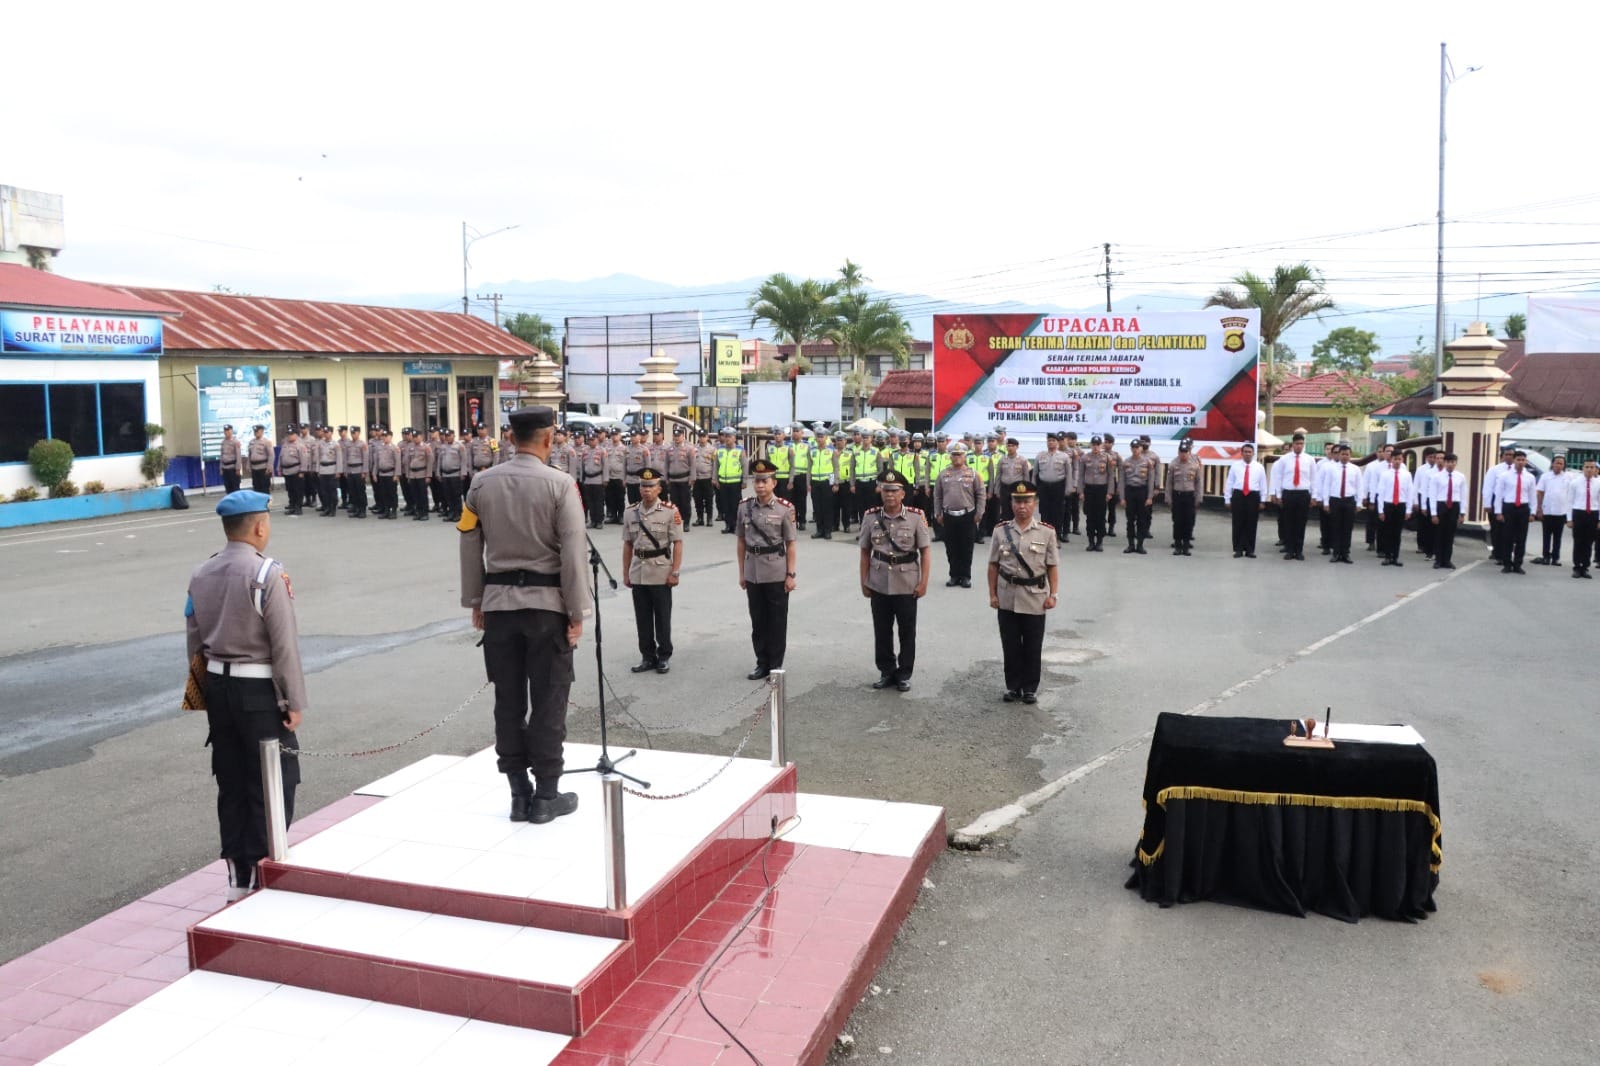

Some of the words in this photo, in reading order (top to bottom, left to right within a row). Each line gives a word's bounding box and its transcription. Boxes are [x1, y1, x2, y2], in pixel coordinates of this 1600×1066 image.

[33, 316, 139, 333] PELAYANAN
[1043, 317, 1141, 333] UPACARA
[15, 331, 56, 343] SURAT
[60, 333, 84, 344] IZIN
[88, 333, 153, 345] MENGEMUDI
[989, 335, 1022, 350] SERAH
[1024, 335, 1064, 350] TERIMA
[1066, 335, 1112, 350] JABATAN
[1113, 335, 1136, 350] dan
[1138, 335, 1207, 350] PELANTIKAN
[1047, 354, 1074, 362] SERAH
[1076, 354, 1107, 362] TERIMA
[1108, 354, 1145, 362] JABATAN
[1112, 366, 1136, 374] KERINCI
[1017, 377, 1030, 386] AKP
[1031, 377, 1046, 386] YUDI
[1119, 378, 1132, 387] AKP
[1067, 392, 1120, 400] PELANTIKAN
[988, 412, 1004, 421] IPTU
[1006, 412, 1037, 422] KHAIRUL
[1075, 413, 1088, 423] S.E.
[1111, 415, 1129, 425] IPTU
[1131, 415, 1147, 425] ALTI
[1182, 416, 1197, 426] S.H.
